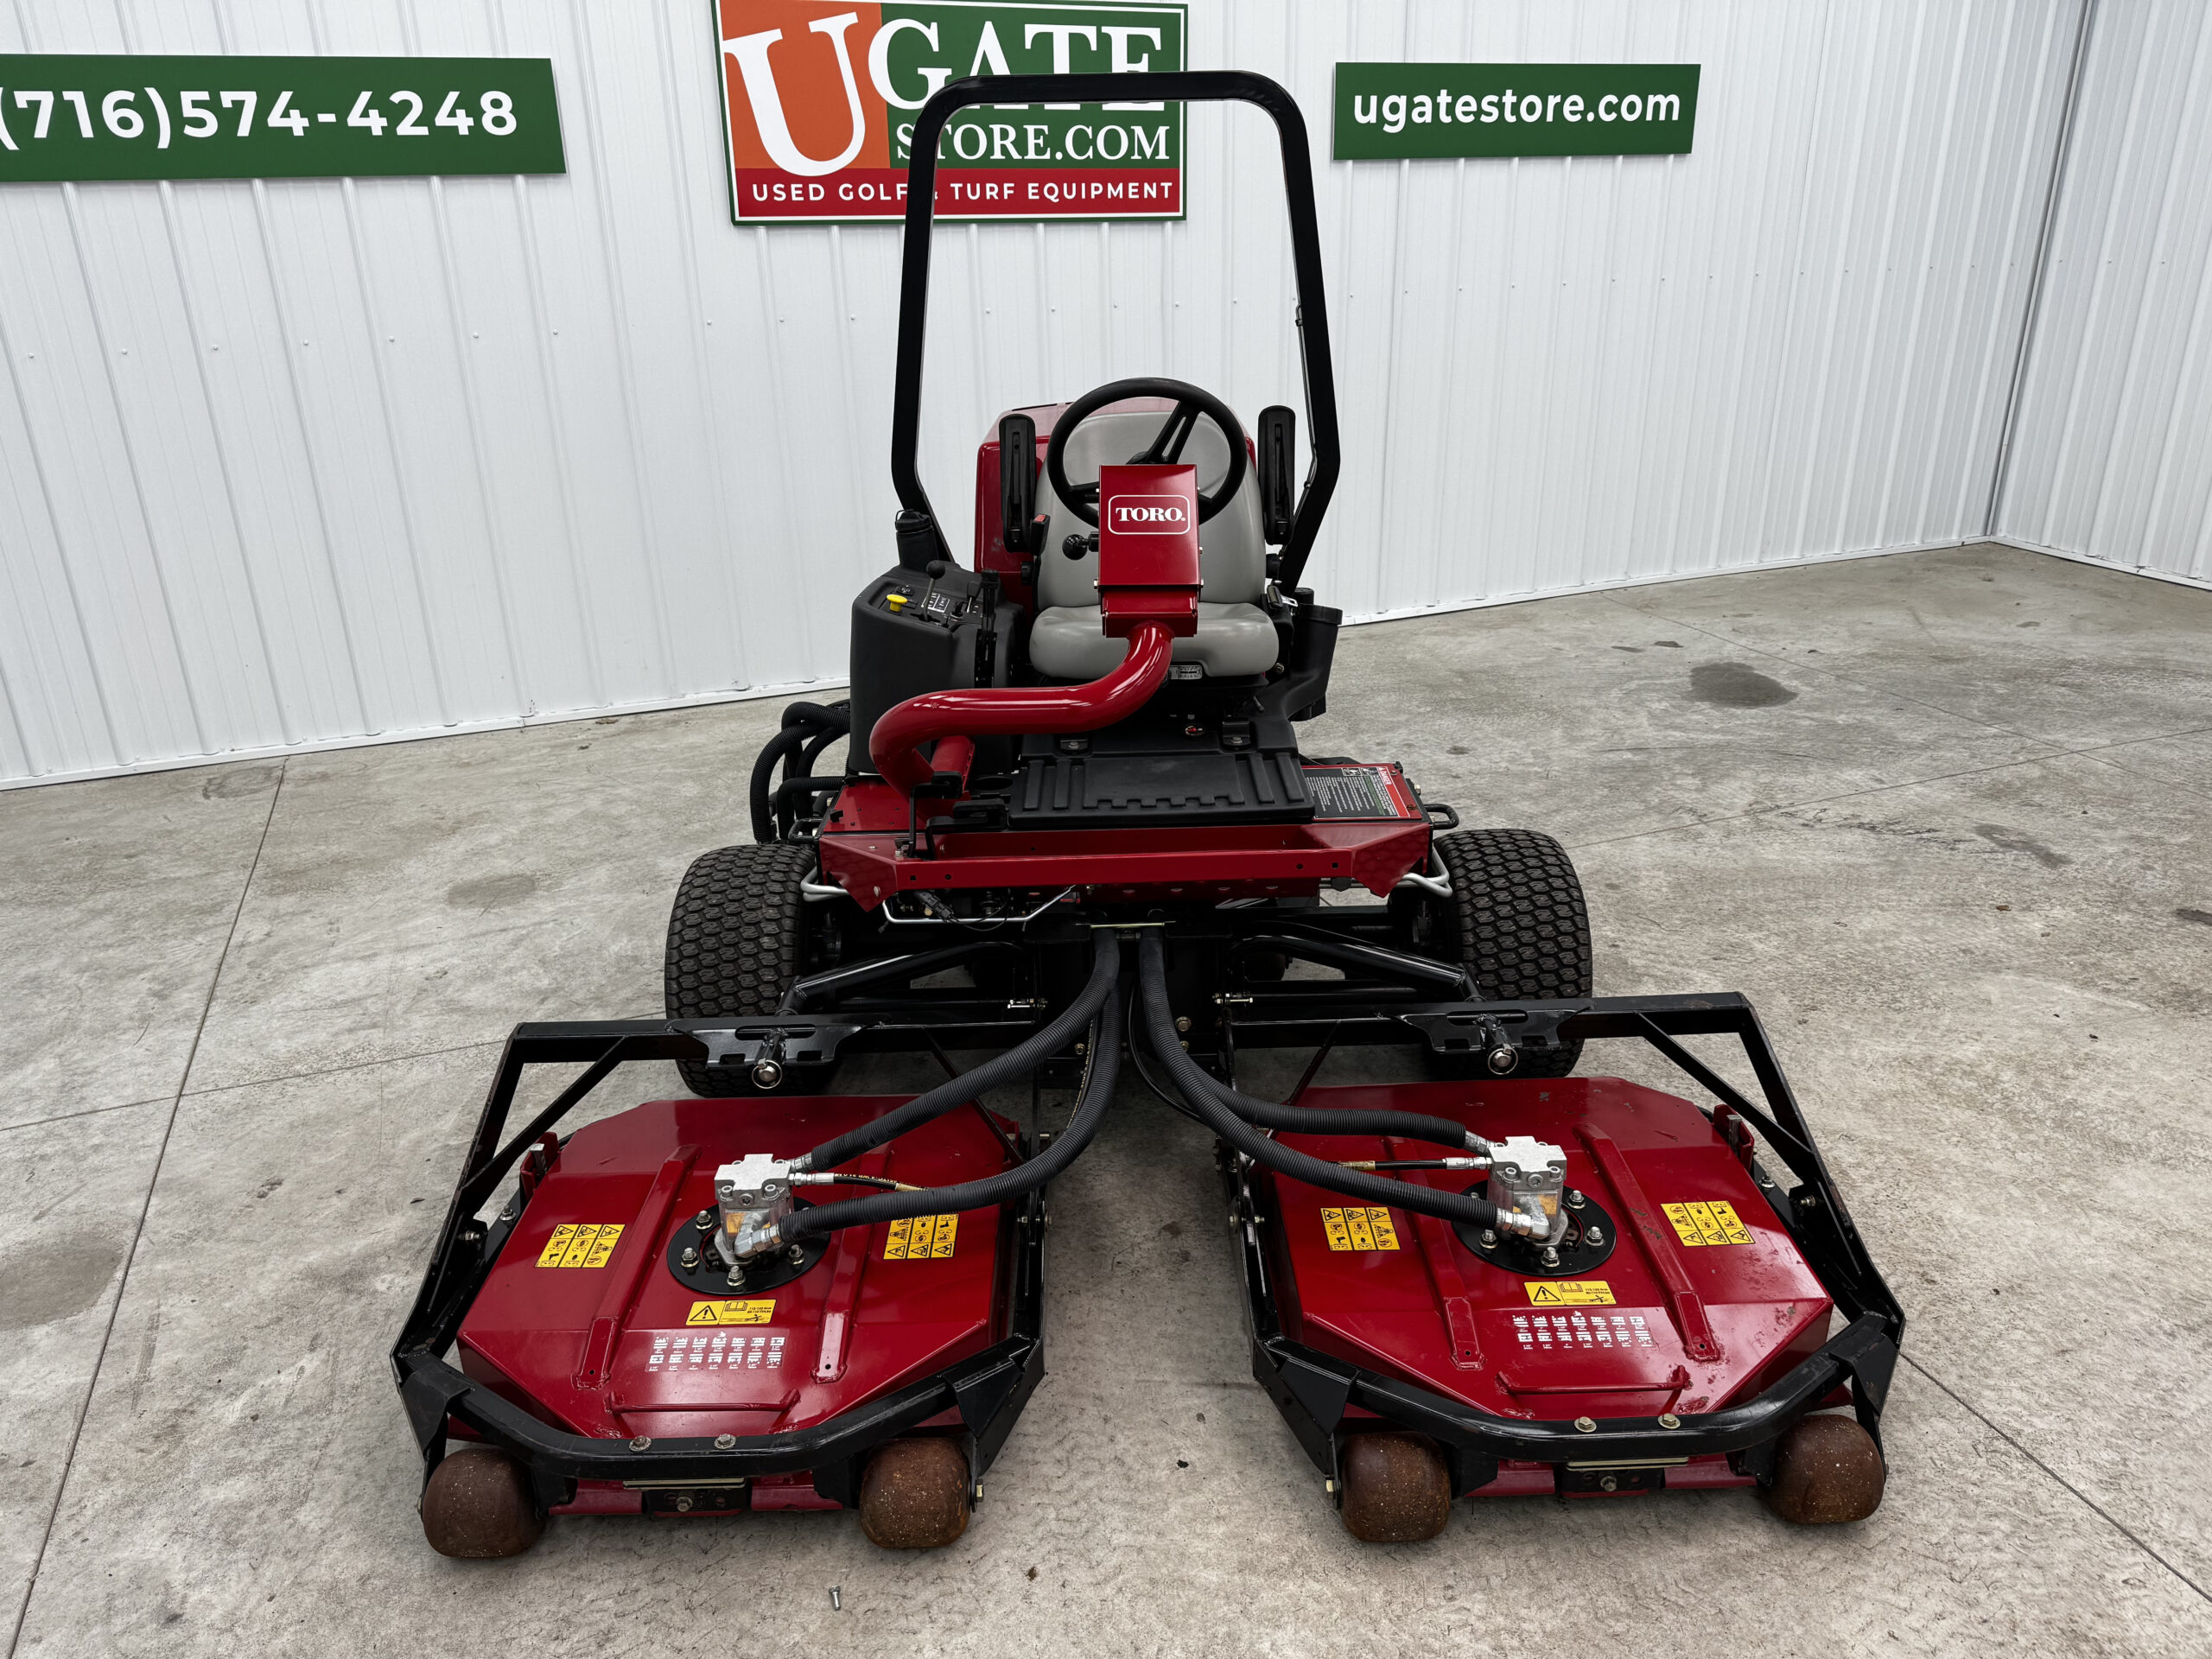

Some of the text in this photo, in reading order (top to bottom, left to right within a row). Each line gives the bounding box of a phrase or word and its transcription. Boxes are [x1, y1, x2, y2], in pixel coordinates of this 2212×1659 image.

[0, 87, 517, 149] (716)574-4248
[1354, 89, 1680, 133] ugatestore.com
[753, 183, 825, 201] USED
[838, 183, 908, 200] GOLF
[950, 182, 1015, 200] TURF
[1027, 181, 1173, 203] EQUIPMENT
